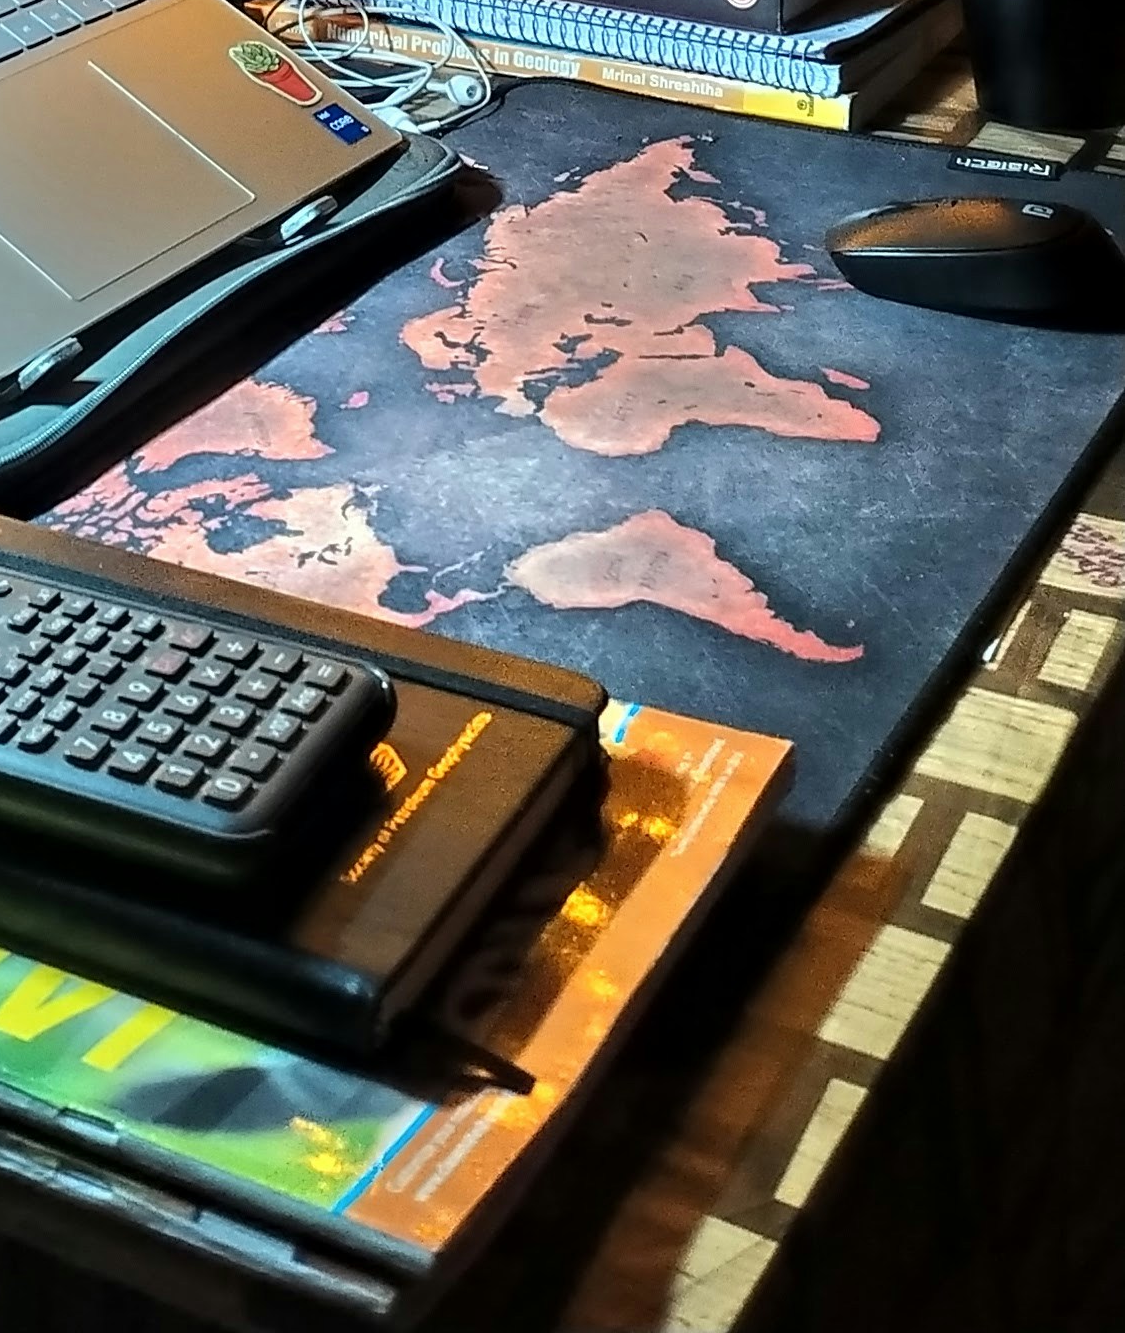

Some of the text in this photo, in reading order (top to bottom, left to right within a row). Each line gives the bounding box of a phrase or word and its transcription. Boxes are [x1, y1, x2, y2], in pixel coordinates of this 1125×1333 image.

[494, 47, 510, 66] in
[513, 51, 581, 79] Geology
[601, 66, 646, 86] Mrinal
[649, 74, 724, 99] Shreshtha
[129, 682, 152, 696] 9
[175, 693, 198, 708] 6
[102, 709, 126, 724] 8
[219, 705, 245, 720] 3
[146, 720, 173, 736] 5
[74, 736, 98, 752] 7
[195, 734, 221, 750] 2
[123, 749, 146, 765] 4
[167, 764, 195, 776] 1
[215, 777, 242, 793] 0
